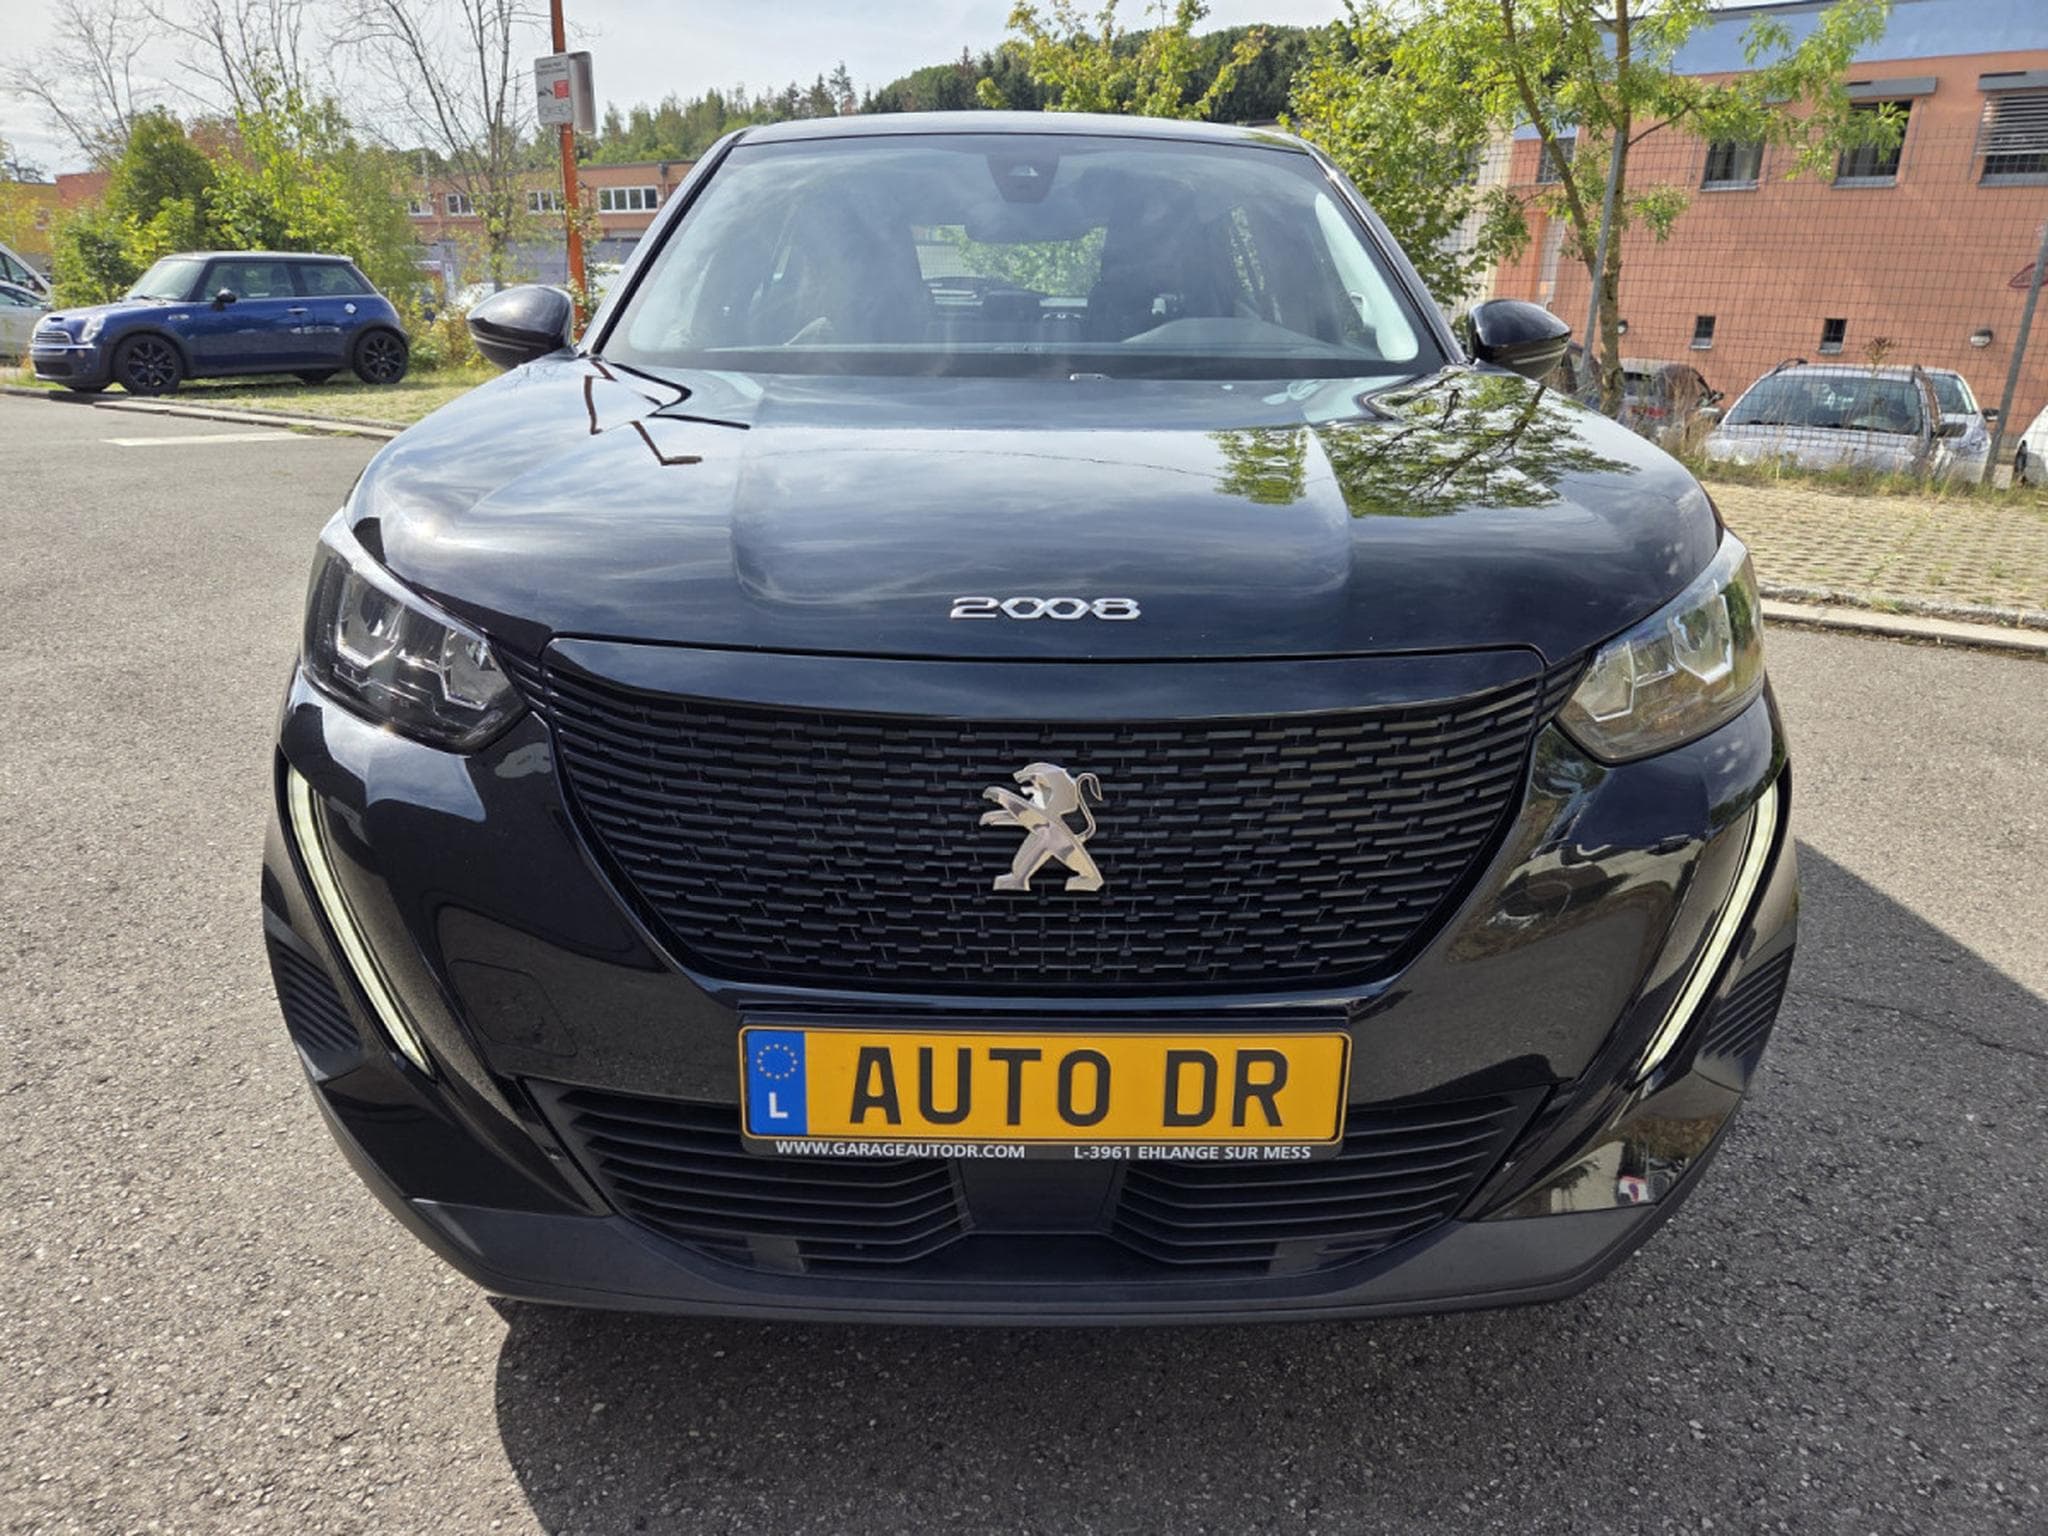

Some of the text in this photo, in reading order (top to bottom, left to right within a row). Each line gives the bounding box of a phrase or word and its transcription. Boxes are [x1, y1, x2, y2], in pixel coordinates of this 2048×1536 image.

[950, 596, 1141, 620] 2008
[850, 1046, 1288, 1127] AUTO DR
[768, 1091, 788, 1119] L
[775, 1140, 1026, 1159] WWW.GARAGEAUTODR.COM
[1074, 1145, 1311, 1160] L-3961 EHLANGE SUR MESS
